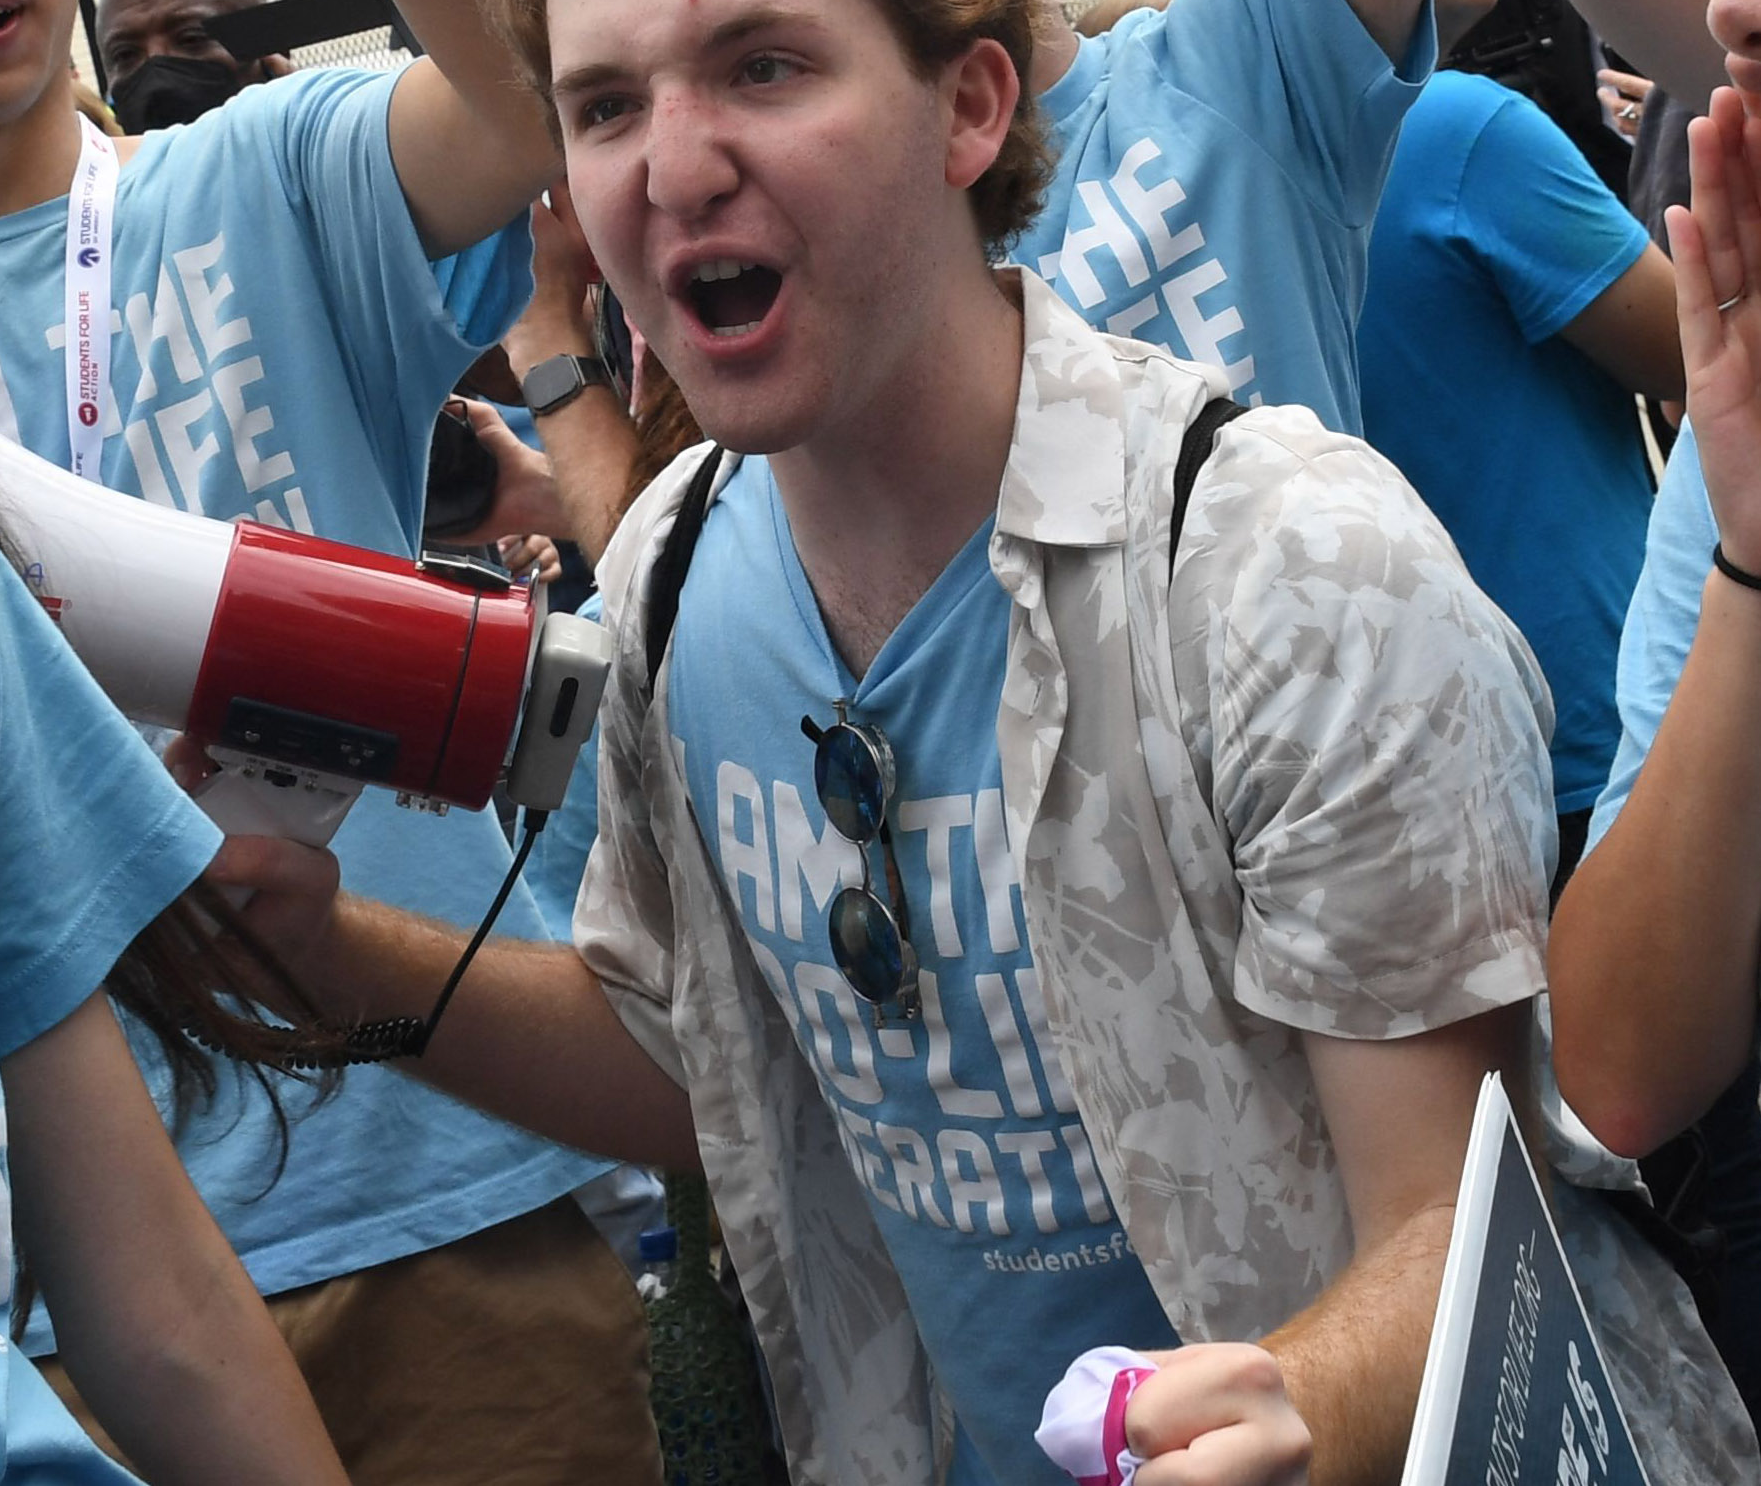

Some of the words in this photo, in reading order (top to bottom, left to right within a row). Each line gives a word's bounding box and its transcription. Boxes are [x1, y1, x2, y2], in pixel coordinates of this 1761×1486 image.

[1038, 136, 1206, 310] HE
[78, 290, 90, 312] LIFE
[79, 315, 90, 339] FOR
[79, 340, 90, 400] STUDENTS
[91, 363, 99, 402] ACTION
